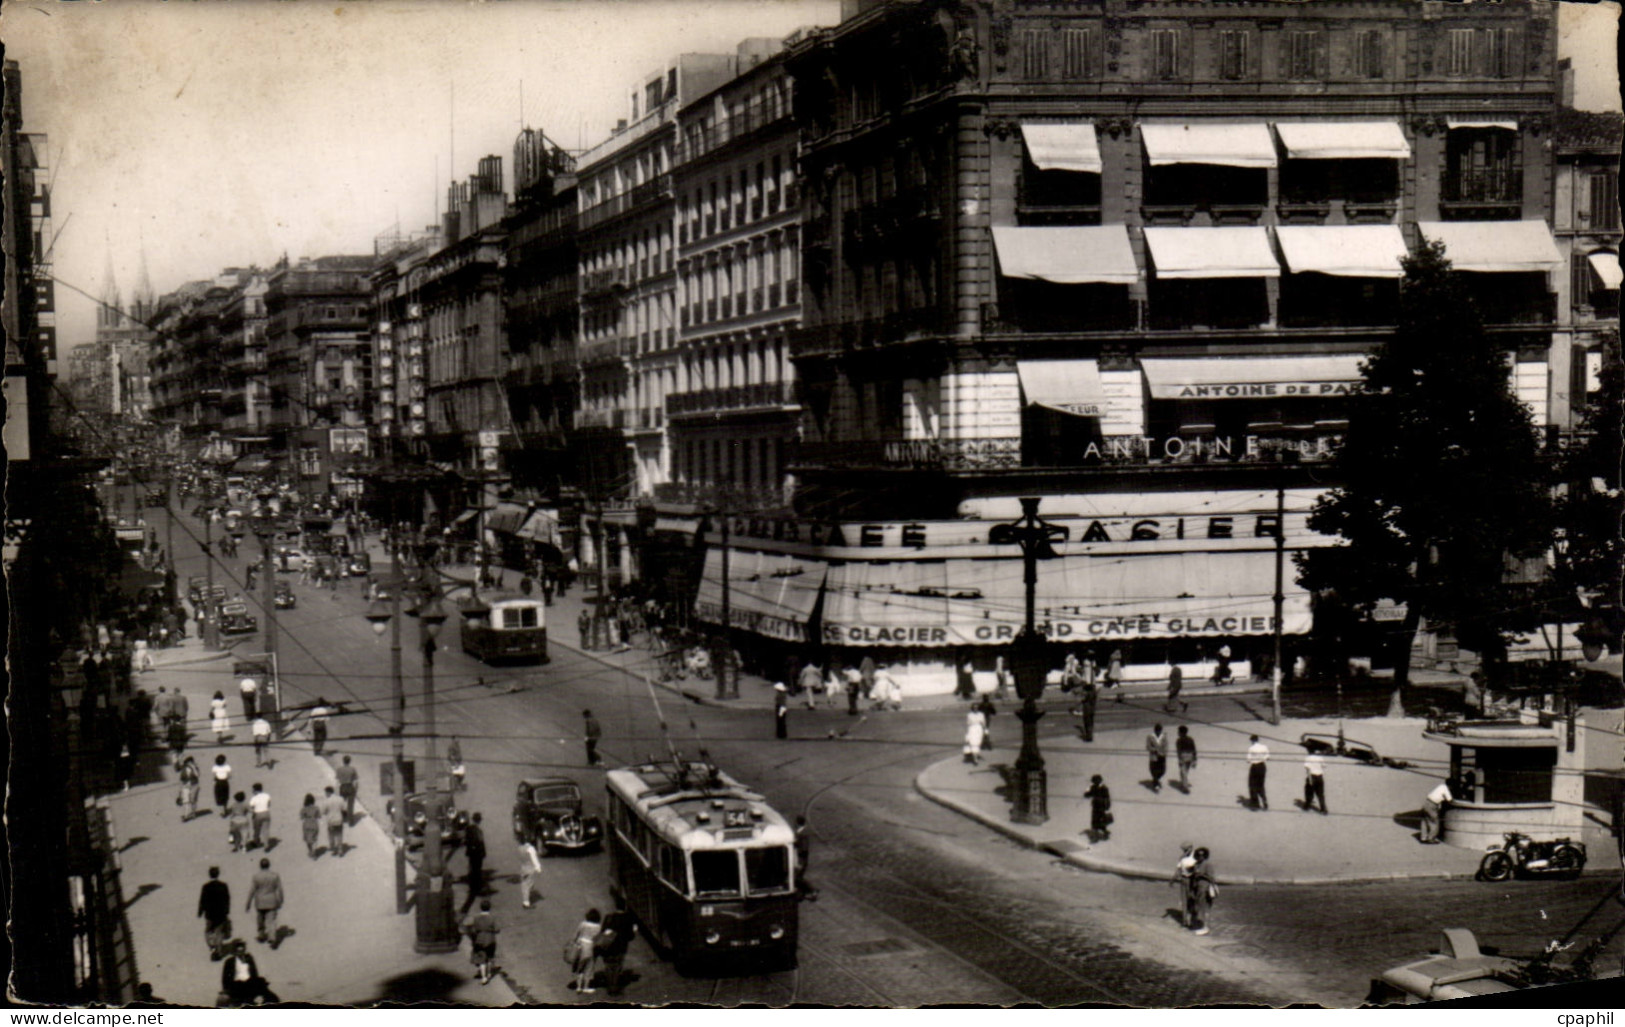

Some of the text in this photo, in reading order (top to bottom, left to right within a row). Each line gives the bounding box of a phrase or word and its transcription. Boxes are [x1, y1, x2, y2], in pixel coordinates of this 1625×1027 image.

[1180, 383, 1363, 397] ANTOINE DE PAR
[1084, 436, 1257, 458] ANTOINE
[989, 515, 1283, 544] GACIER
[848, 626, 948, 642] GLACIER
[975, 622, 1073, 640] GRND
[1167, 617, 1283, 632] GLACIER
